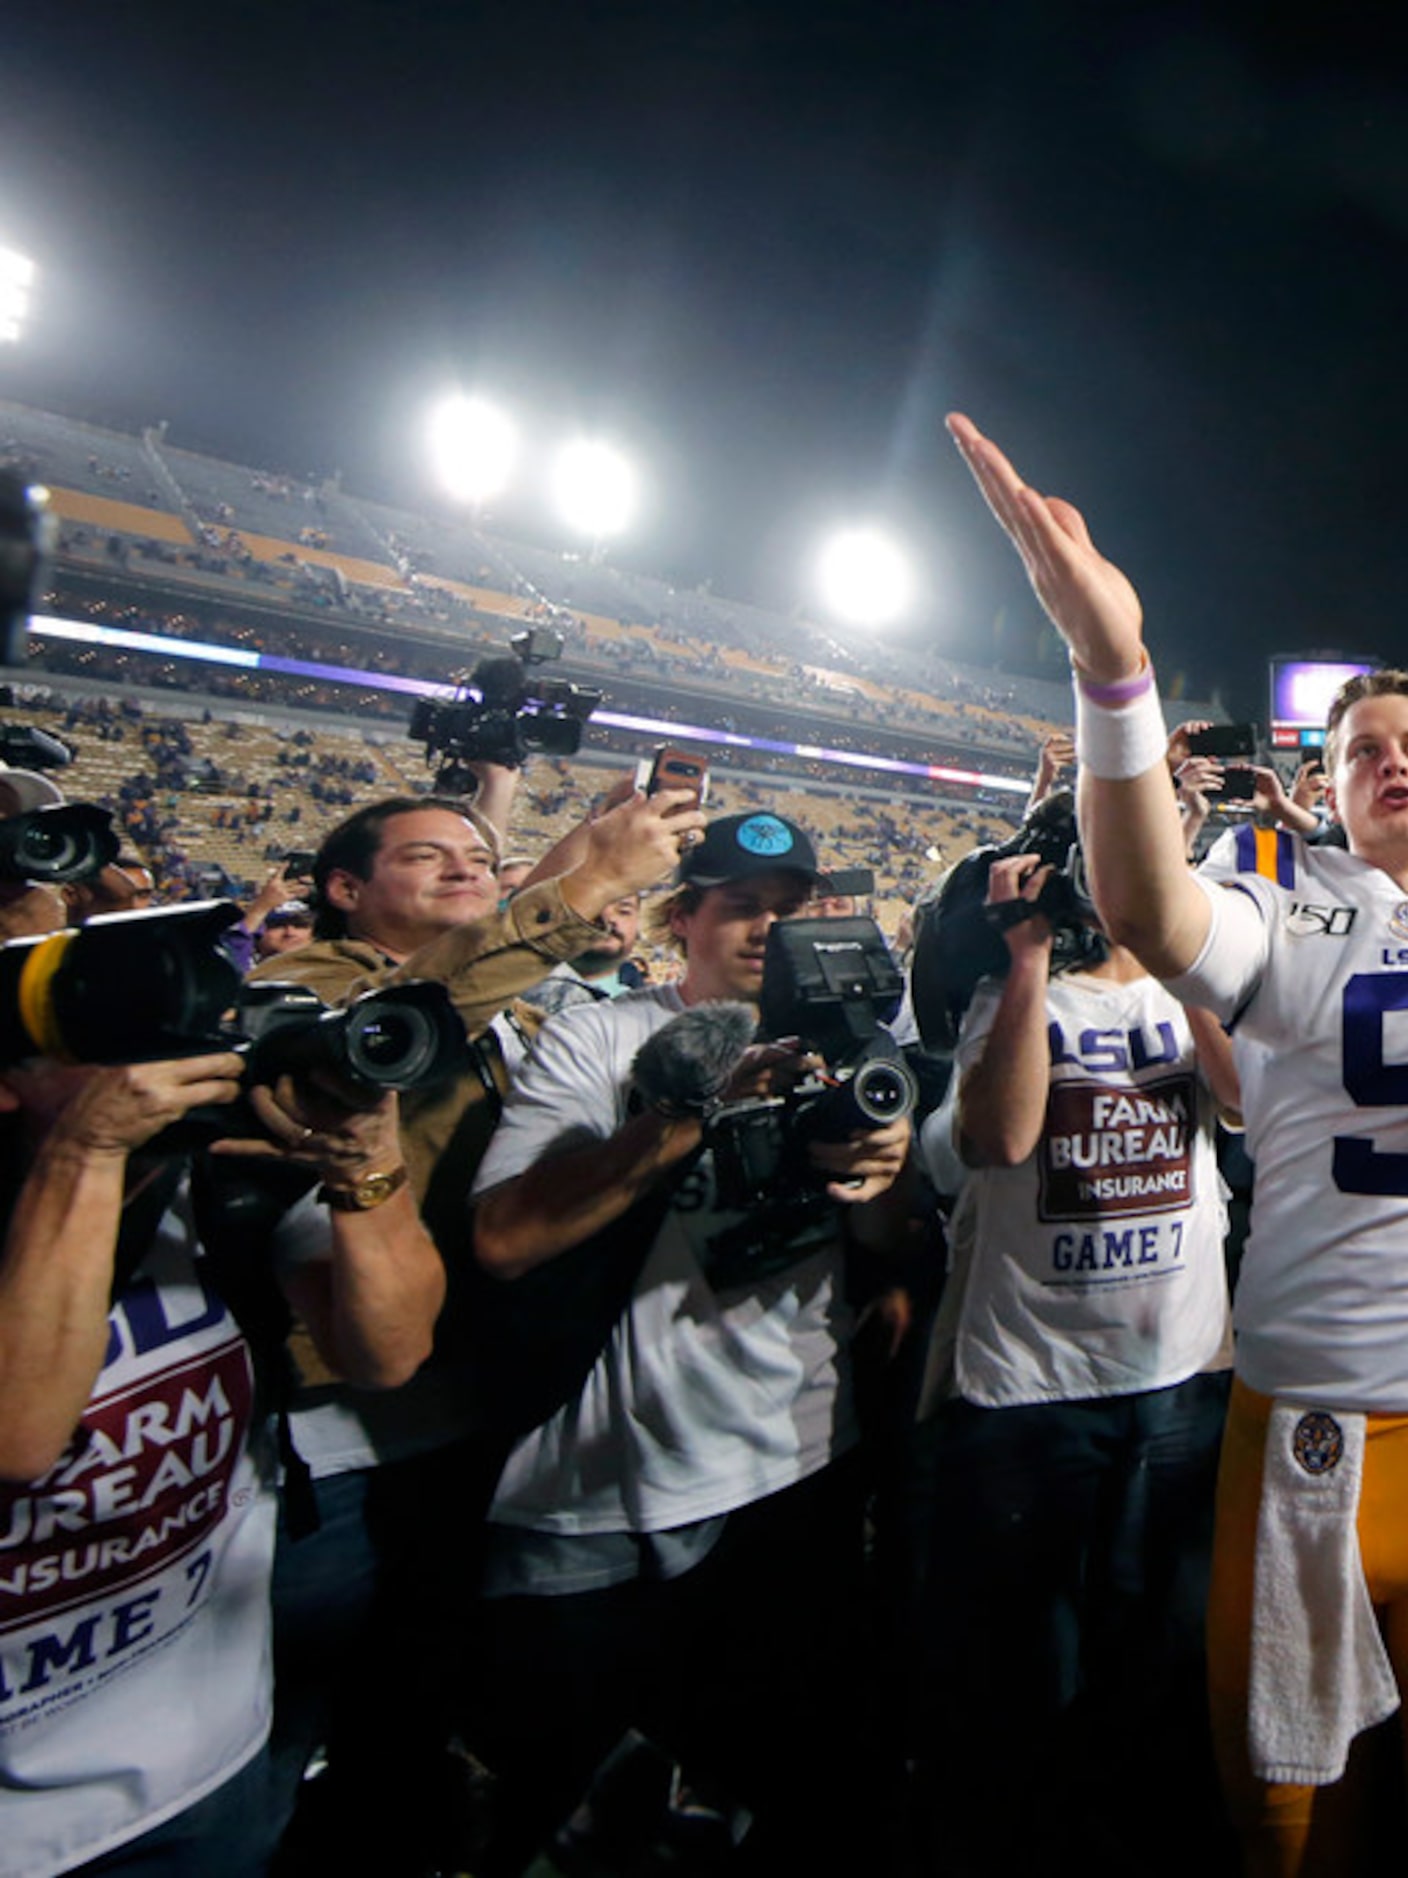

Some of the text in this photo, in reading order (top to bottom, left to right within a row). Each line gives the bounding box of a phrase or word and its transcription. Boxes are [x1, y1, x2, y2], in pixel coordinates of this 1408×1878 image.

[1048, 1020, 1179, 1073] LSU
[1051, 1126, 1188, 1170] BUREAU
[1079, 1170, 1187, 1200] INSURANCE
[1053, 1220, 1184, 1272] GAME 7
[0, 1416, 235, 1550] UREAU
[0, 1481, 225, 1596] NSURANCE
[0, 1587, 163, 1700] ME
[186, 1549, 212, 1609] 7
